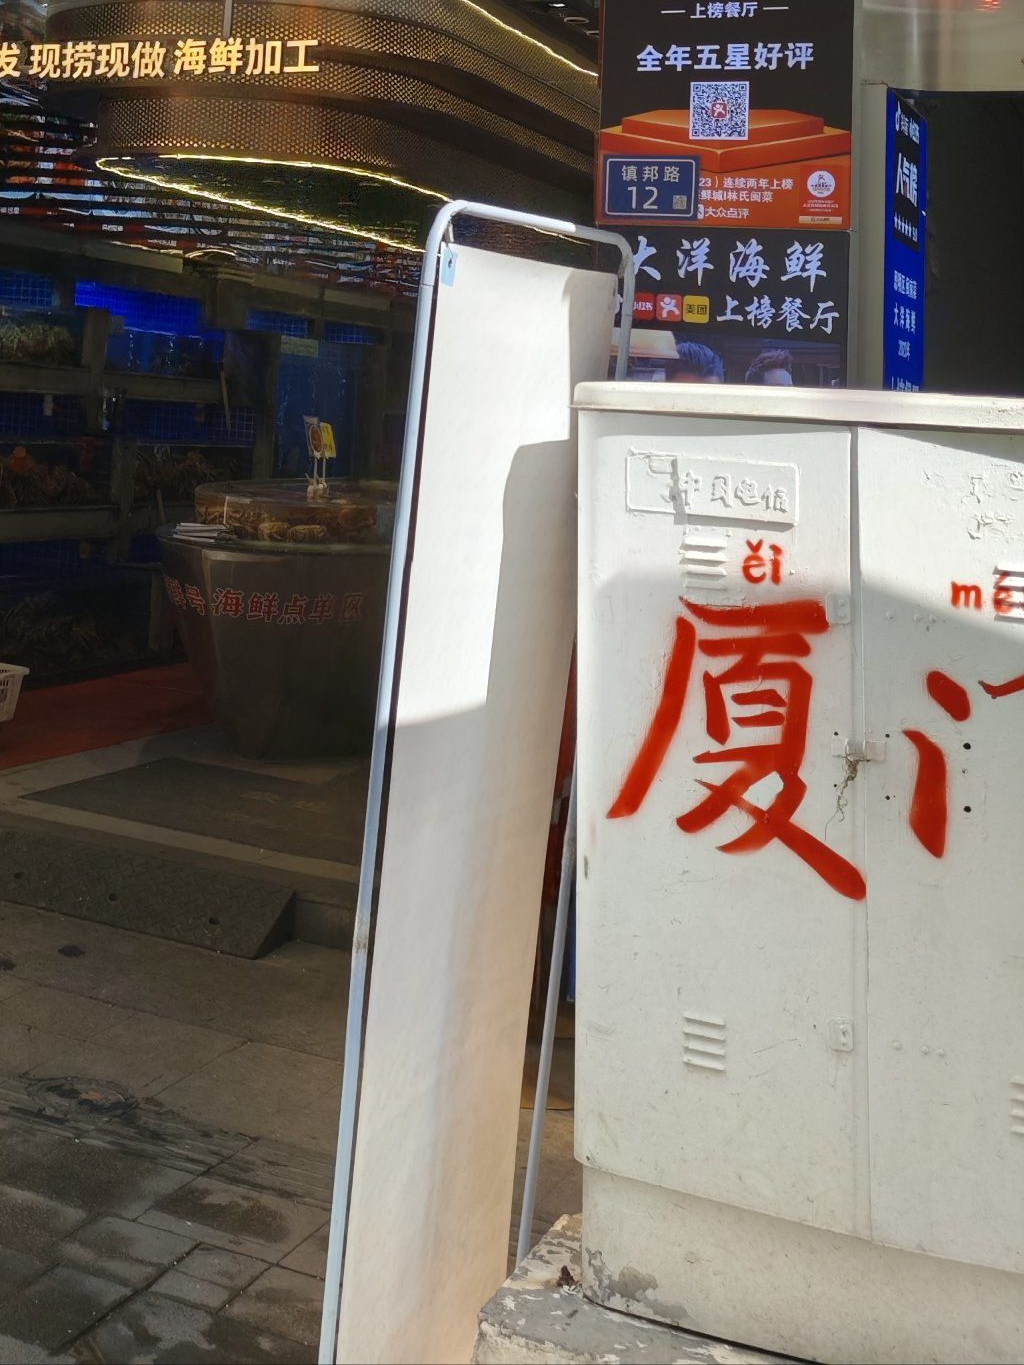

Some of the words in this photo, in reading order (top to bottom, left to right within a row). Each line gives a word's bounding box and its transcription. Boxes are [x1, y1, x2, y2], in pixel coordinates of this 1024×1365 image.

[690, 1, 758, 19] 上榜餐厅
[29, 40, 166, 80] 现捞现做
[173, 37, 320, 76] 海鲜加工
[636, 42, 814, 72] 全年五星好评
[621, 165, 681, 183] 镇邦路
[627, 186, 659, 210] 12
[704, 207, 750, 219] 大众点评
[633, 235, 827, 293] 大洋海鲜
[685, 303, 708, 315] 美团
[716, 293, 840, 334] 上榜餐厅
